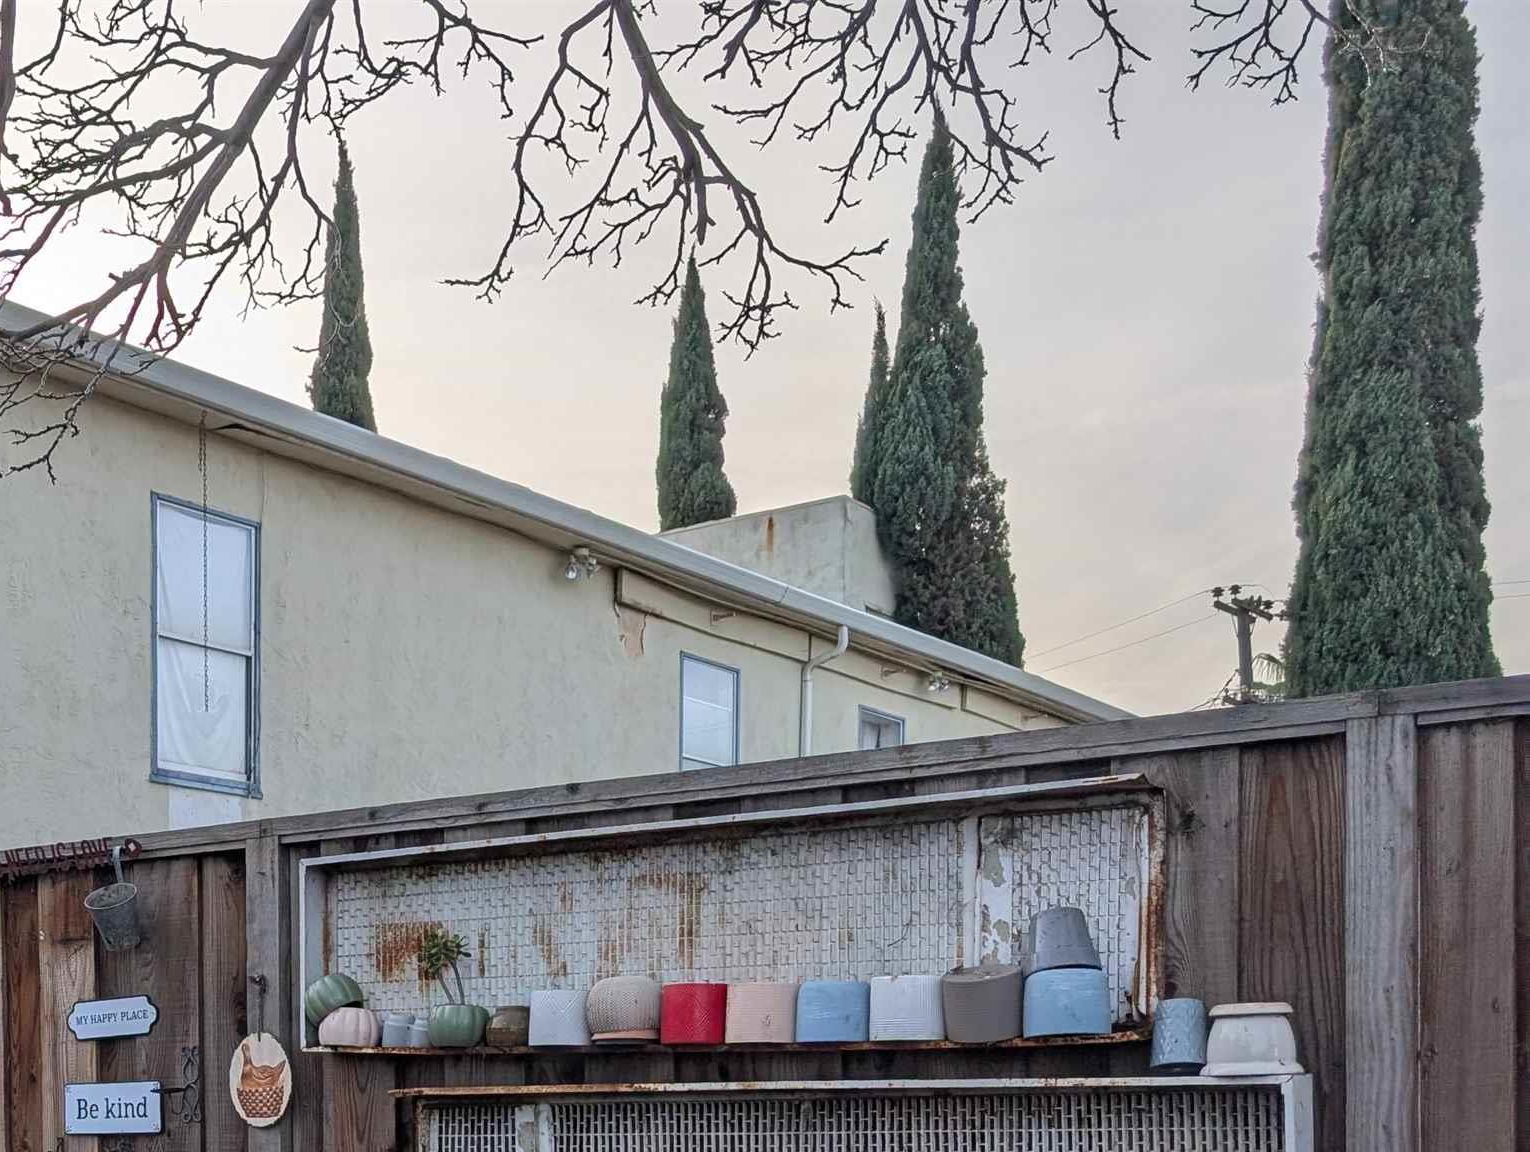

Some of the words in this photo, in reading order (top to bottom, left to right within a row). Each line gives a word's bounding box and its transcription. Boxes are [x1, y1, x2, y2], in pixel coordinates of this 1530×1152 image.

[5, 845, 46, 867] NEED
[71, 836, 111, 858] LOVE
[76, 1015, 89, 1026] MY
[90, 1012, 118, 1025] HAPPY
[120, 1009, 150, 1021] PLACE
[76, 1098, 99, 1120] Be
[103, 1095, 149, 1119] kind
